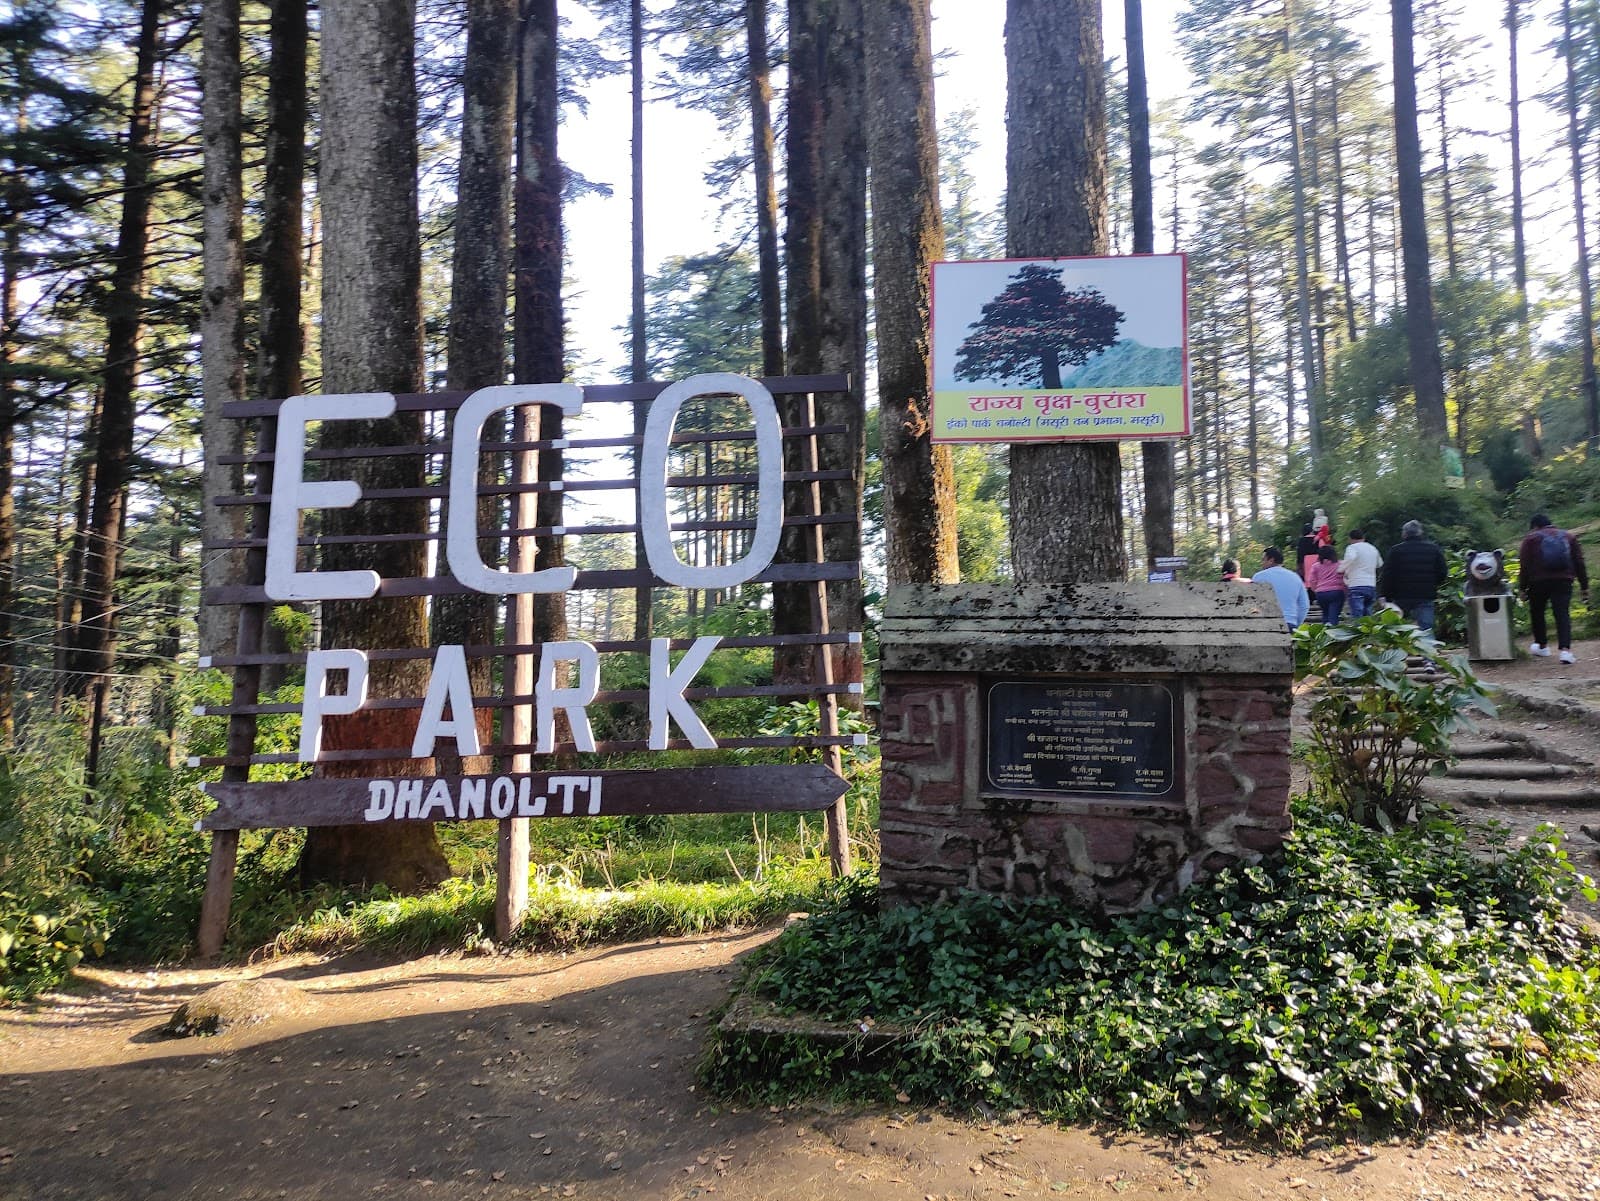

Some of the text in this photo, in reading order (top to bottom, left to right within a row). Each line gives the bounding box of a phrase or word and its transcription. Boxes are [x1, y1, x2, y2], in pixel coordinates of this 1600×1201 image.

[968, 395, 1024, 411] राज्य
[972, 417, 992, 428] पार्क
[1073, 416, 1090, 426] वन
[265, 372, 785, 600] ECO
[298, 635, 722, 764] PARK
[1026, 732, 1035, 742] श्री
[364, 775, 602, 822] DHANOLTI
